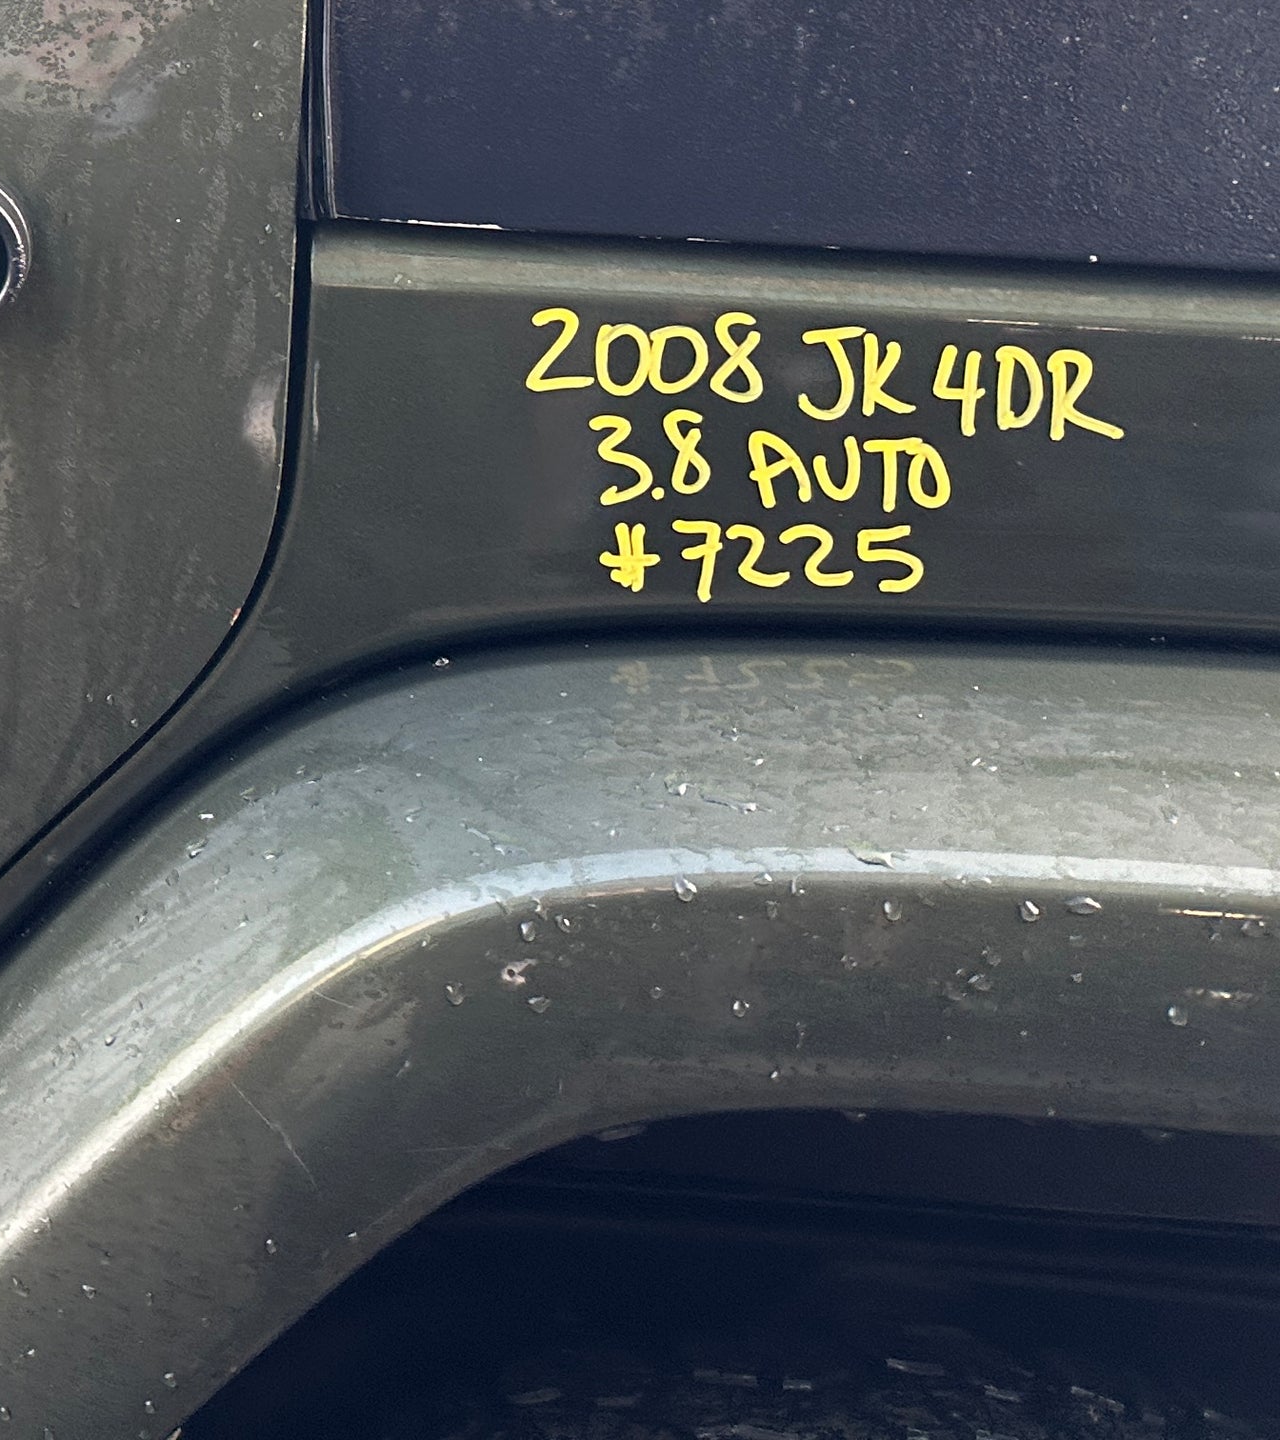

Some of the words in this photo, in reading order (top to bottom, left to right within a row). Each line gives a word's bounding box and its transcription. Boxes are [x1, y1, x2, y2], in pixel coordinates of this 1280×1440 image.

[525, 307, 763, 403] 2008
[798, 326, 916, 421] JK
[932, 344, 1125, 441] 4DR
[589, 408, 711, 505] 3.8
[750, 431, 952, 513] AUTO
[599, 519, 925, 603] #7225
